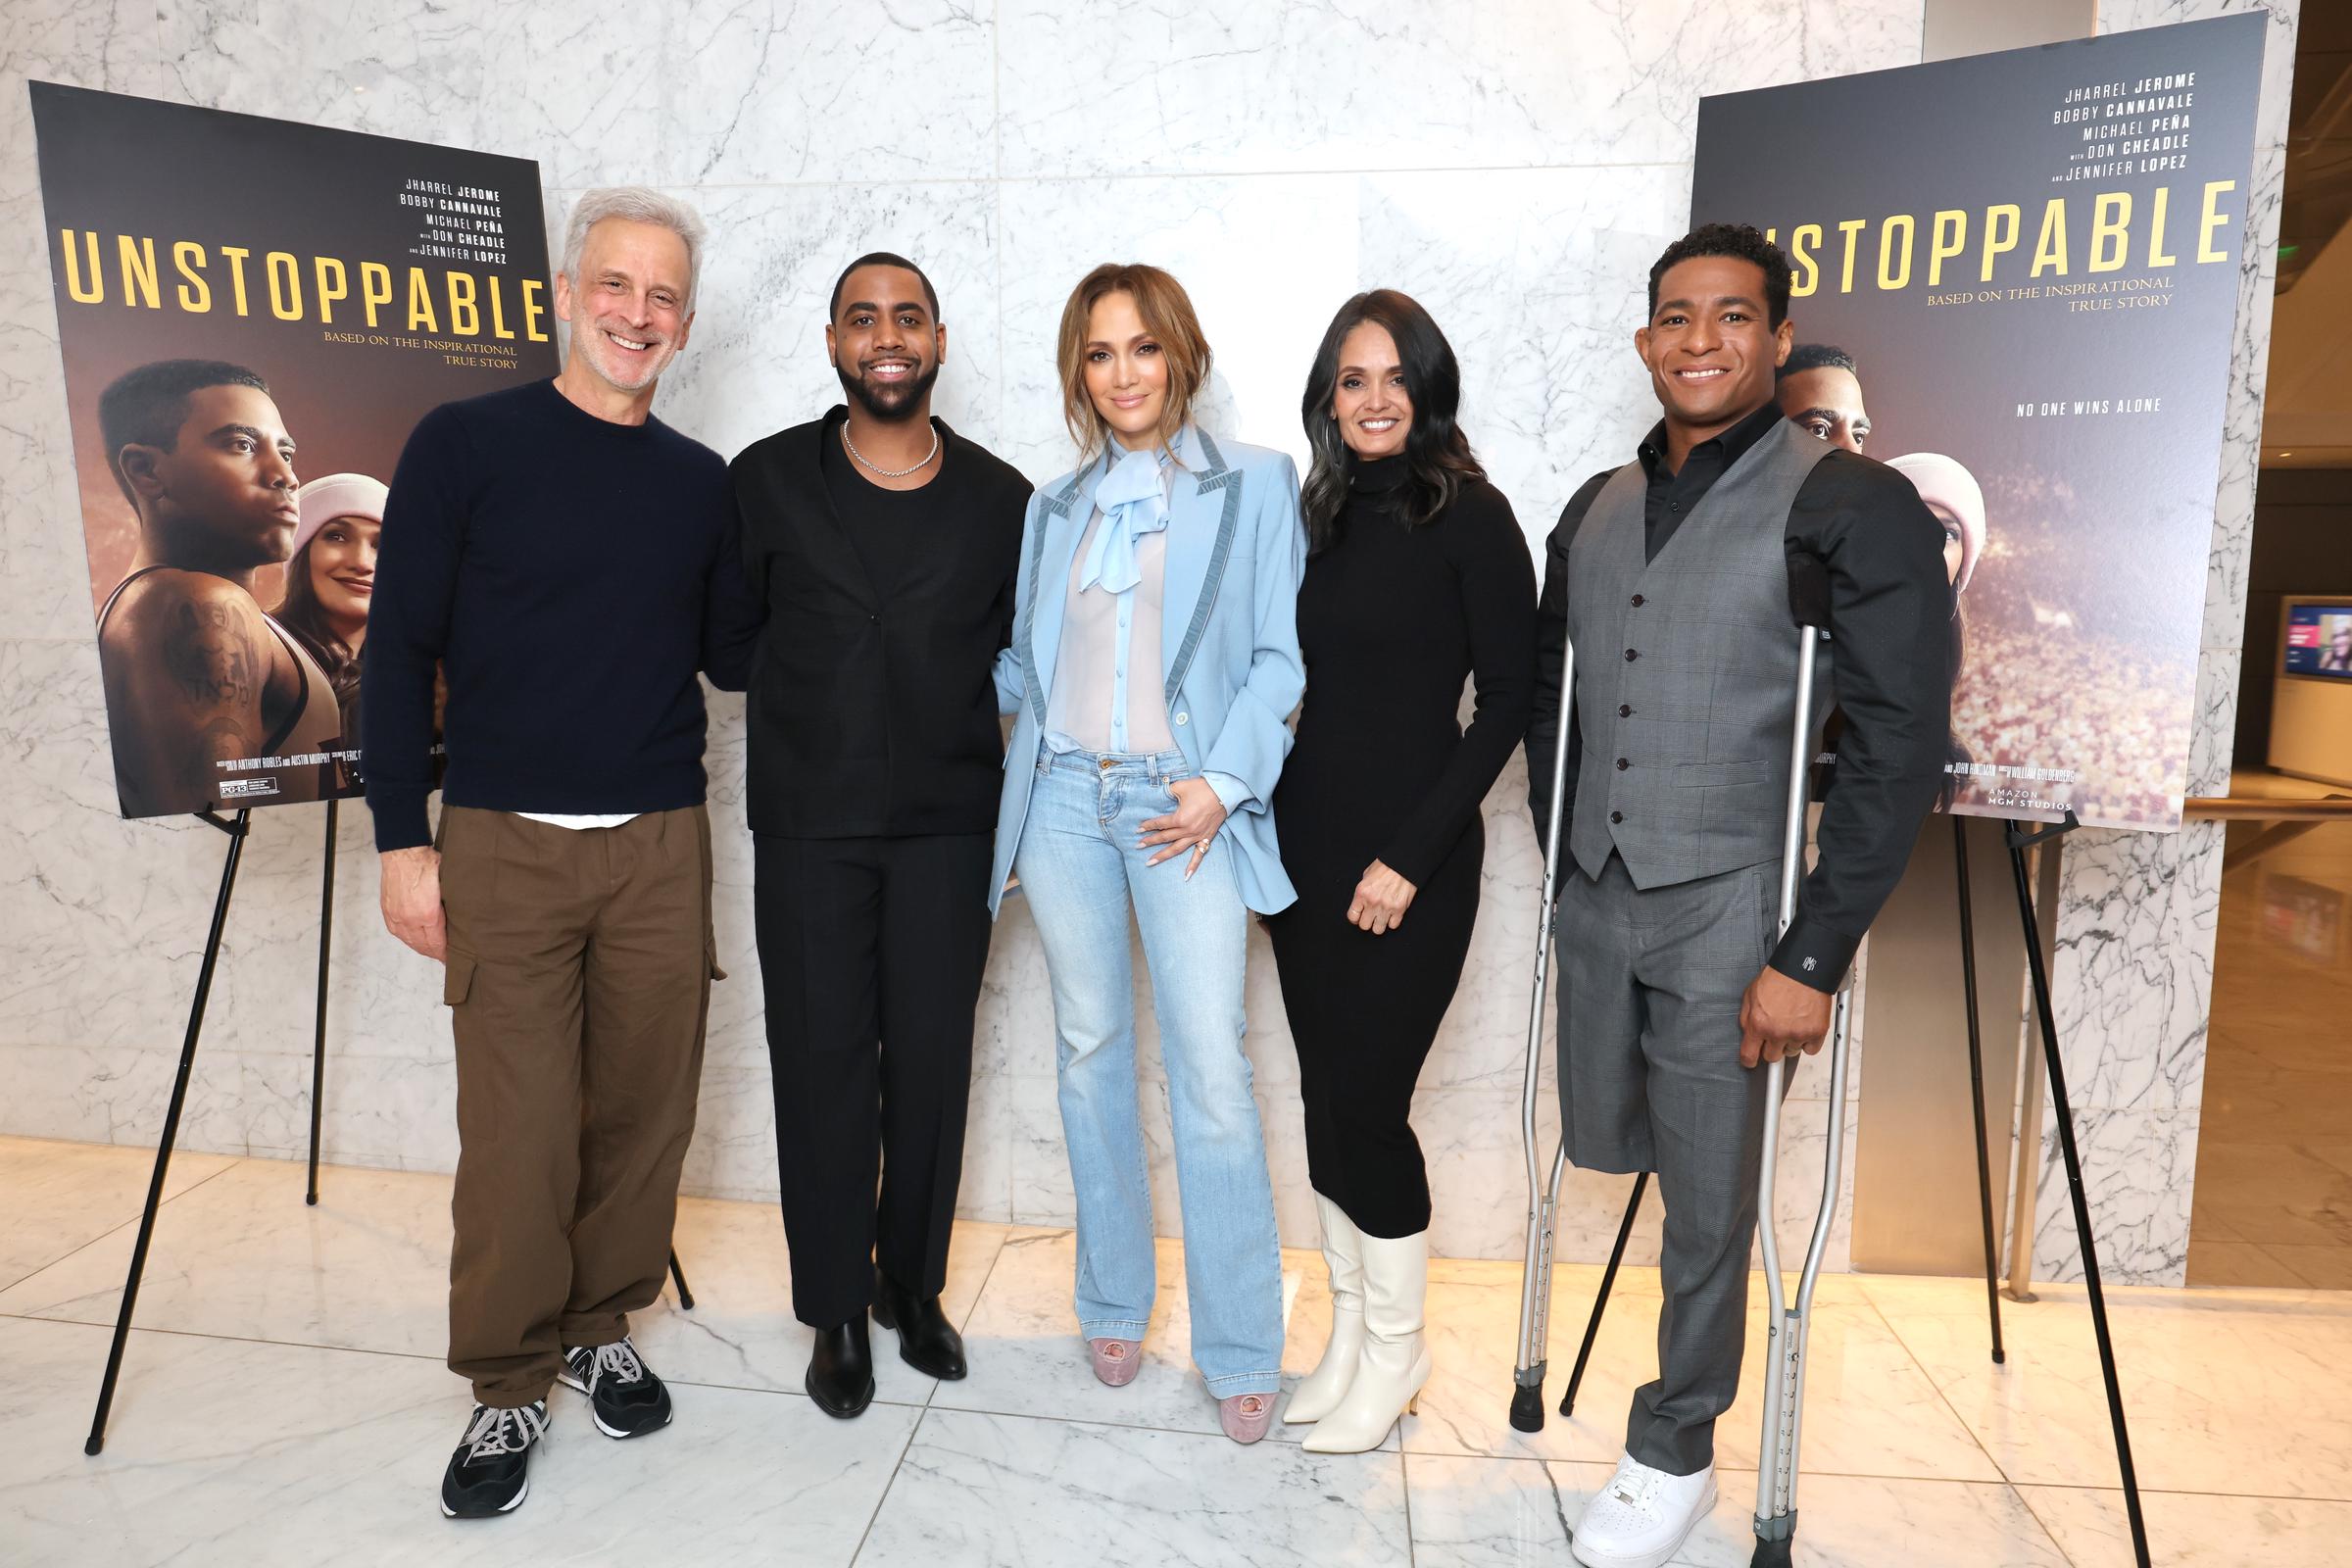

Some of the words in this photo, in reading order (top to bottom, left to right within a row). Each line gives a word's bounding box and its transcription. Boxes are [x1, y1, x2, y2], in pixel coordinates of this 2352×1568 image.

[2065, 81, 2127, 104] JHARREL
[2134, 72, 2195, 94] JEROME
[2053, 105, 2099, 124] BOBBY
[2106, 93, 2193, 118] CANNAVALE
[2082, 121, 2143, 142] MICHAEL
[2151, 114, 2190, 132] PEÑA
[2087, 143, 2115, 160] DON
[2123, 134, 2189, 155] CHEADLE
[2066, 161, 2132, 181] JENNIFER
[2140, 154, 2187, 173] LOPEZ
[406, 178, 453, 195] JHARREL
[458, 186, 500, 202] JEROME
[400, 193, 434, 209] BOBBY
[440, 199, 502, 218] CANNAVALE
[425, 214, 470, 230] MICHAEL
[475, 220, 504, 234] PEÑA
[432, 229, 453, 243] DON
[458, 232, 506, 249] CHEADLE
[1767, 179, 2236, 297] STOPPABLE
[419, 244, 469, 261] JENNIFER
[474, 250, 507, 265] LOPEZ
[61, 228, 550, 342] UNSTOPPABLE
[1927, 292, 1974, 306] BASED
[1978, 290, 2002, 303] ON
[2007, 287, 2040, 300] THE
[2045, 276, 2175, 297] INSPIRATIONAL
[2068, 299, 2112, 313] TRUE
[2117, 293, 2173, 309] STORY
[323, 331, 365, 344] BASED
[368, 335, 389, 346] ON
[393, 337, 420, 349] THE
[424, 339, 518, 357] INSPIRATIONAL
[443, 355, 477, 367] TRUE
[479, 358, 517, 369] STORY
[2017, 403, 2034, 417] NO
[2040, 402, 2067, 416] ONE
[2074, 400, 2110, 416] WINS
[2116, 398, 2162, 414] ALONE
[220, 785, 247, 794] PG-13
[1988, 788, 2037, 799] AMAZON
[2020, 800, 2072, 811] STUDIOS
